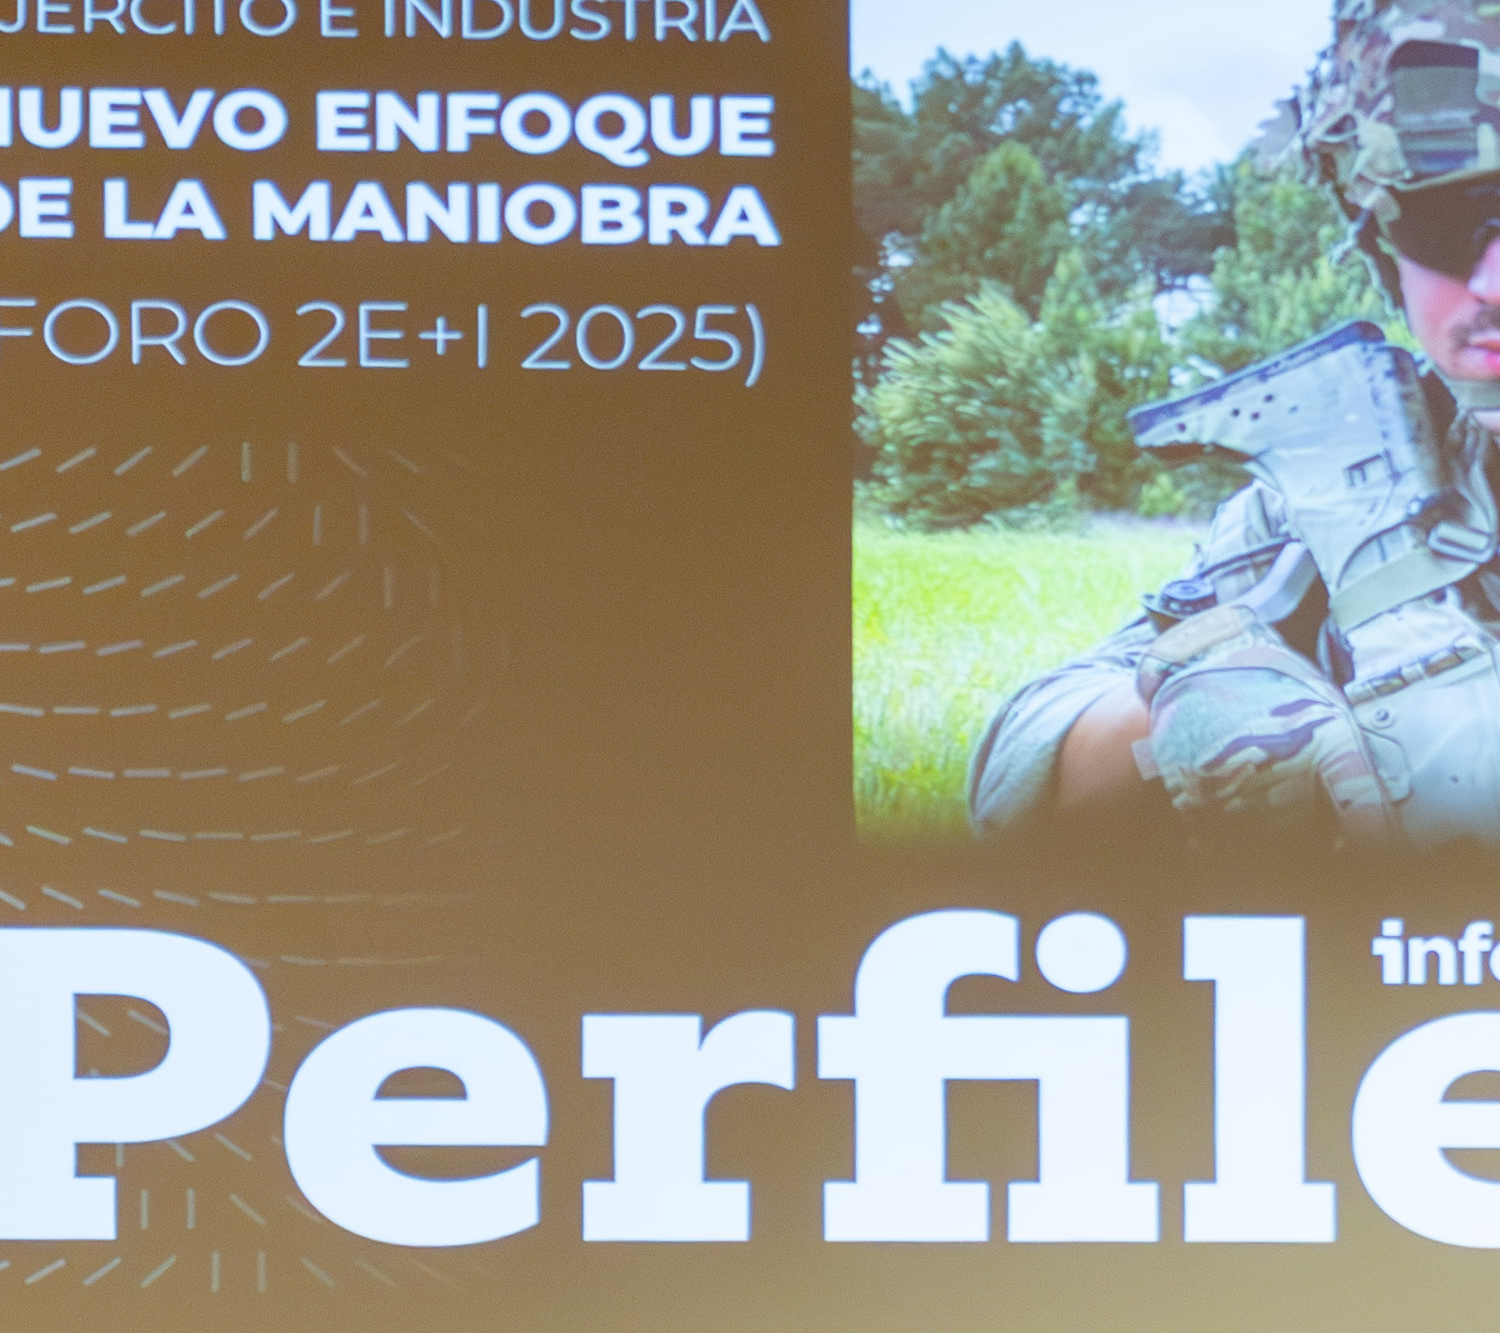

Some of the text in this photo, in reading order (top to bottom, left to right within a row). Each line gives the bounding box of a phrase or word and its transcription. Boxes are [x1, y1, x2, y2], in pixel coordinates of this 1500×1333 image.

[321, 0, 358, 38] E
[384, 0, 772, 43] INDUSTRIA
[315, 92, 775, 167] ENFOQUE
[103, 179, 226, 240] LA
[252, 181, 781, 247] MANIOBRA
[296, 302, 490, 368] 2E+I
[519, 303, 766, 387] 2025)
